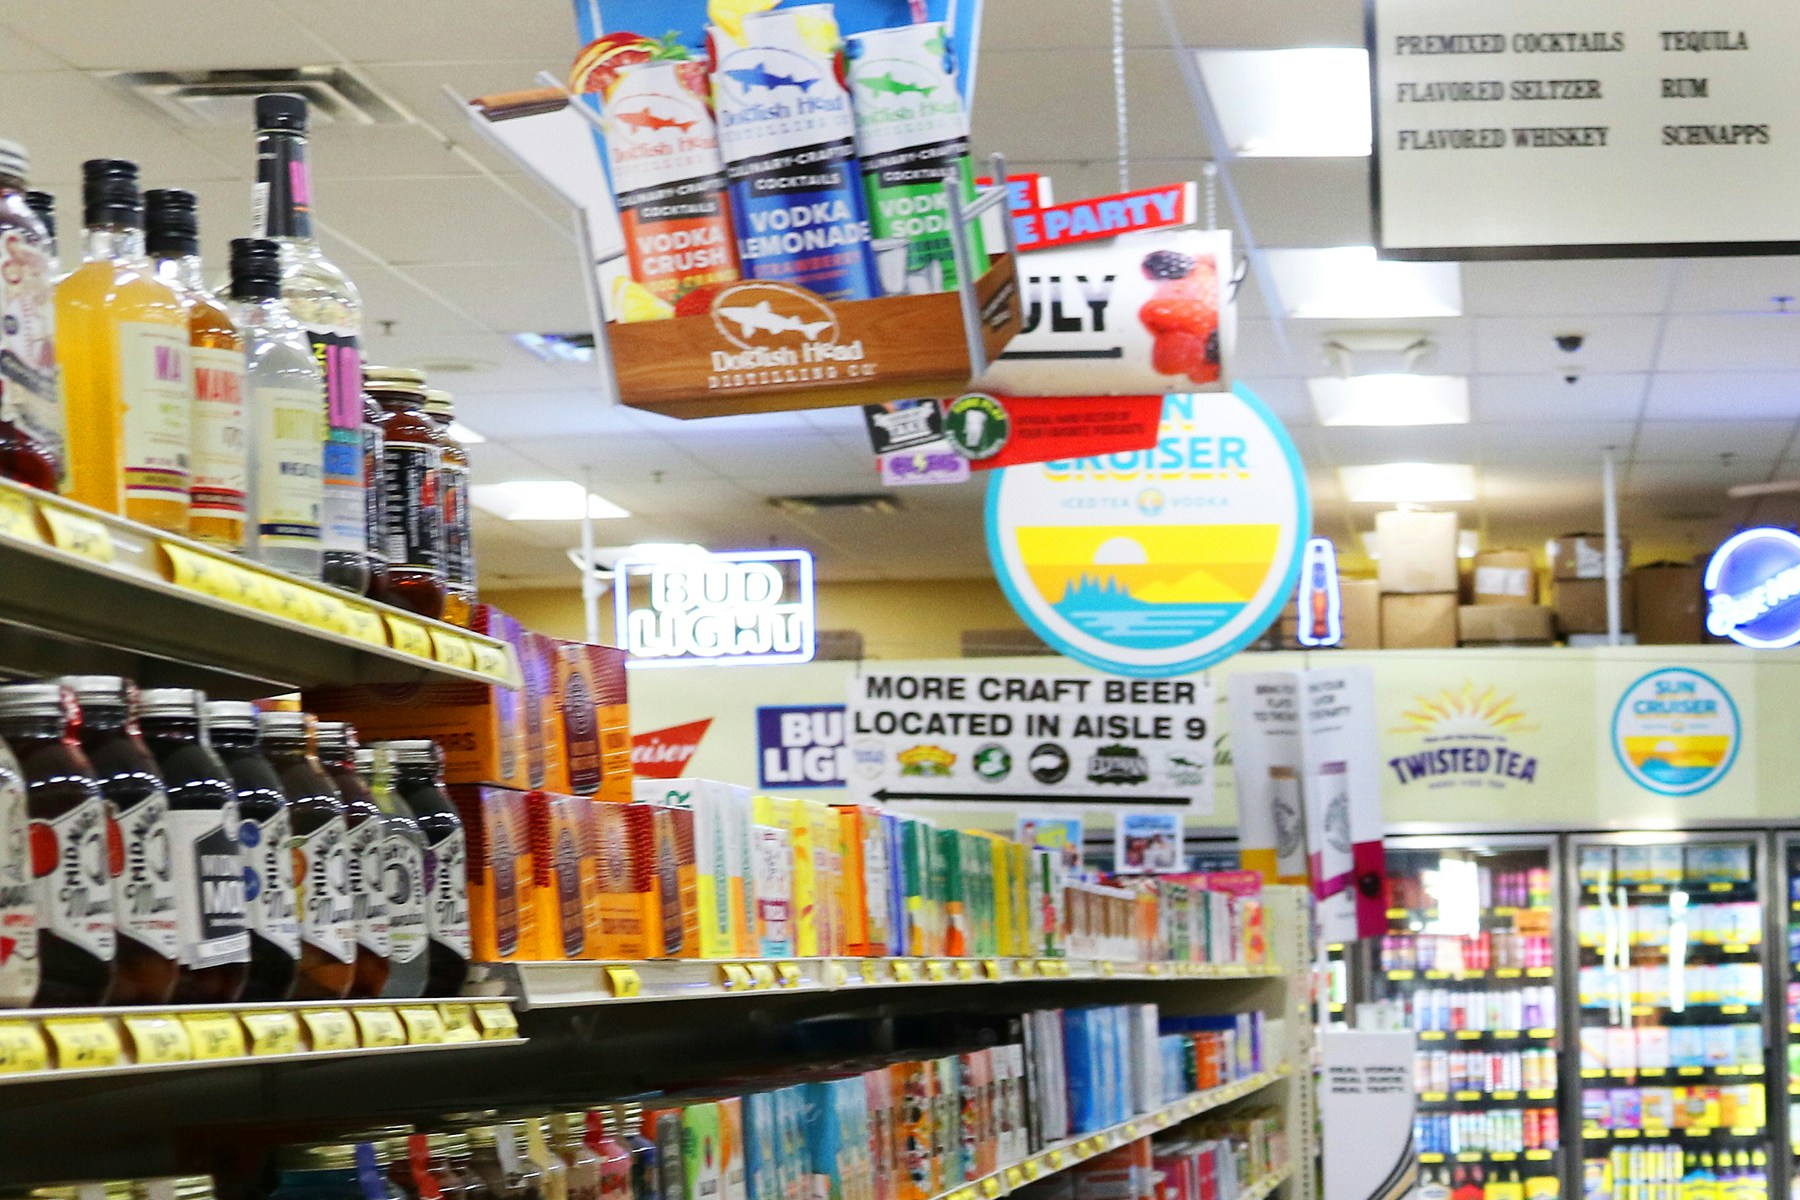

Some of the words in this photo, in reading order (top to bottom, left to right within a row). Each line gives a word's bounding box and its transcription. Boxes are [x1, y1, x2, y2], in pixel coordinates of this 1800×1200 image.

[1396, 34, 1505, 55] PREMIXED
[1511, 32, 1625, 54] COCKTAILS
[1660, 31, 1749, 54] TEQUILA
[1396, 81, 1505, 103] FLAVORED
[1509, 79, 1602, 101] SELTZER
[1660, 78, 1709, 99] RUM
[1397, 128, 1505, 151] FLAVORED
[1511, 126, 1611, 148] WHISKEY
[1661, 125, 1771, 147] SCHNAPPS
[754, 172, 842, 193] COCKTAILS
[749, 201, 852, 233] VODKA
[1043, 188, 1183, 242] PARTY
[636, 226, 725, 254] VODKA
[740, 220, 872, 260] LEMONADE
[641, 249, 726, 277] CRUSH
[866, 675, 965, 702] MORE
[978, 677, 1092, 703] CRAFT
[1103, 680, 1196, 705] BEER
[1654, 680, 1696, 695] SUN
[1633, 699, 1718, 715] CRUISER
[854, 711, 1014, 737] LOCATED
[1026, 714, 1061, 738] IN
[1072, 715, 1172, 740] AISLE
[1185, 717, 1207, 741] 9
[1387, 747, 1491, 786] TWISTED
[1495, 746, 1539, 785] TEA
